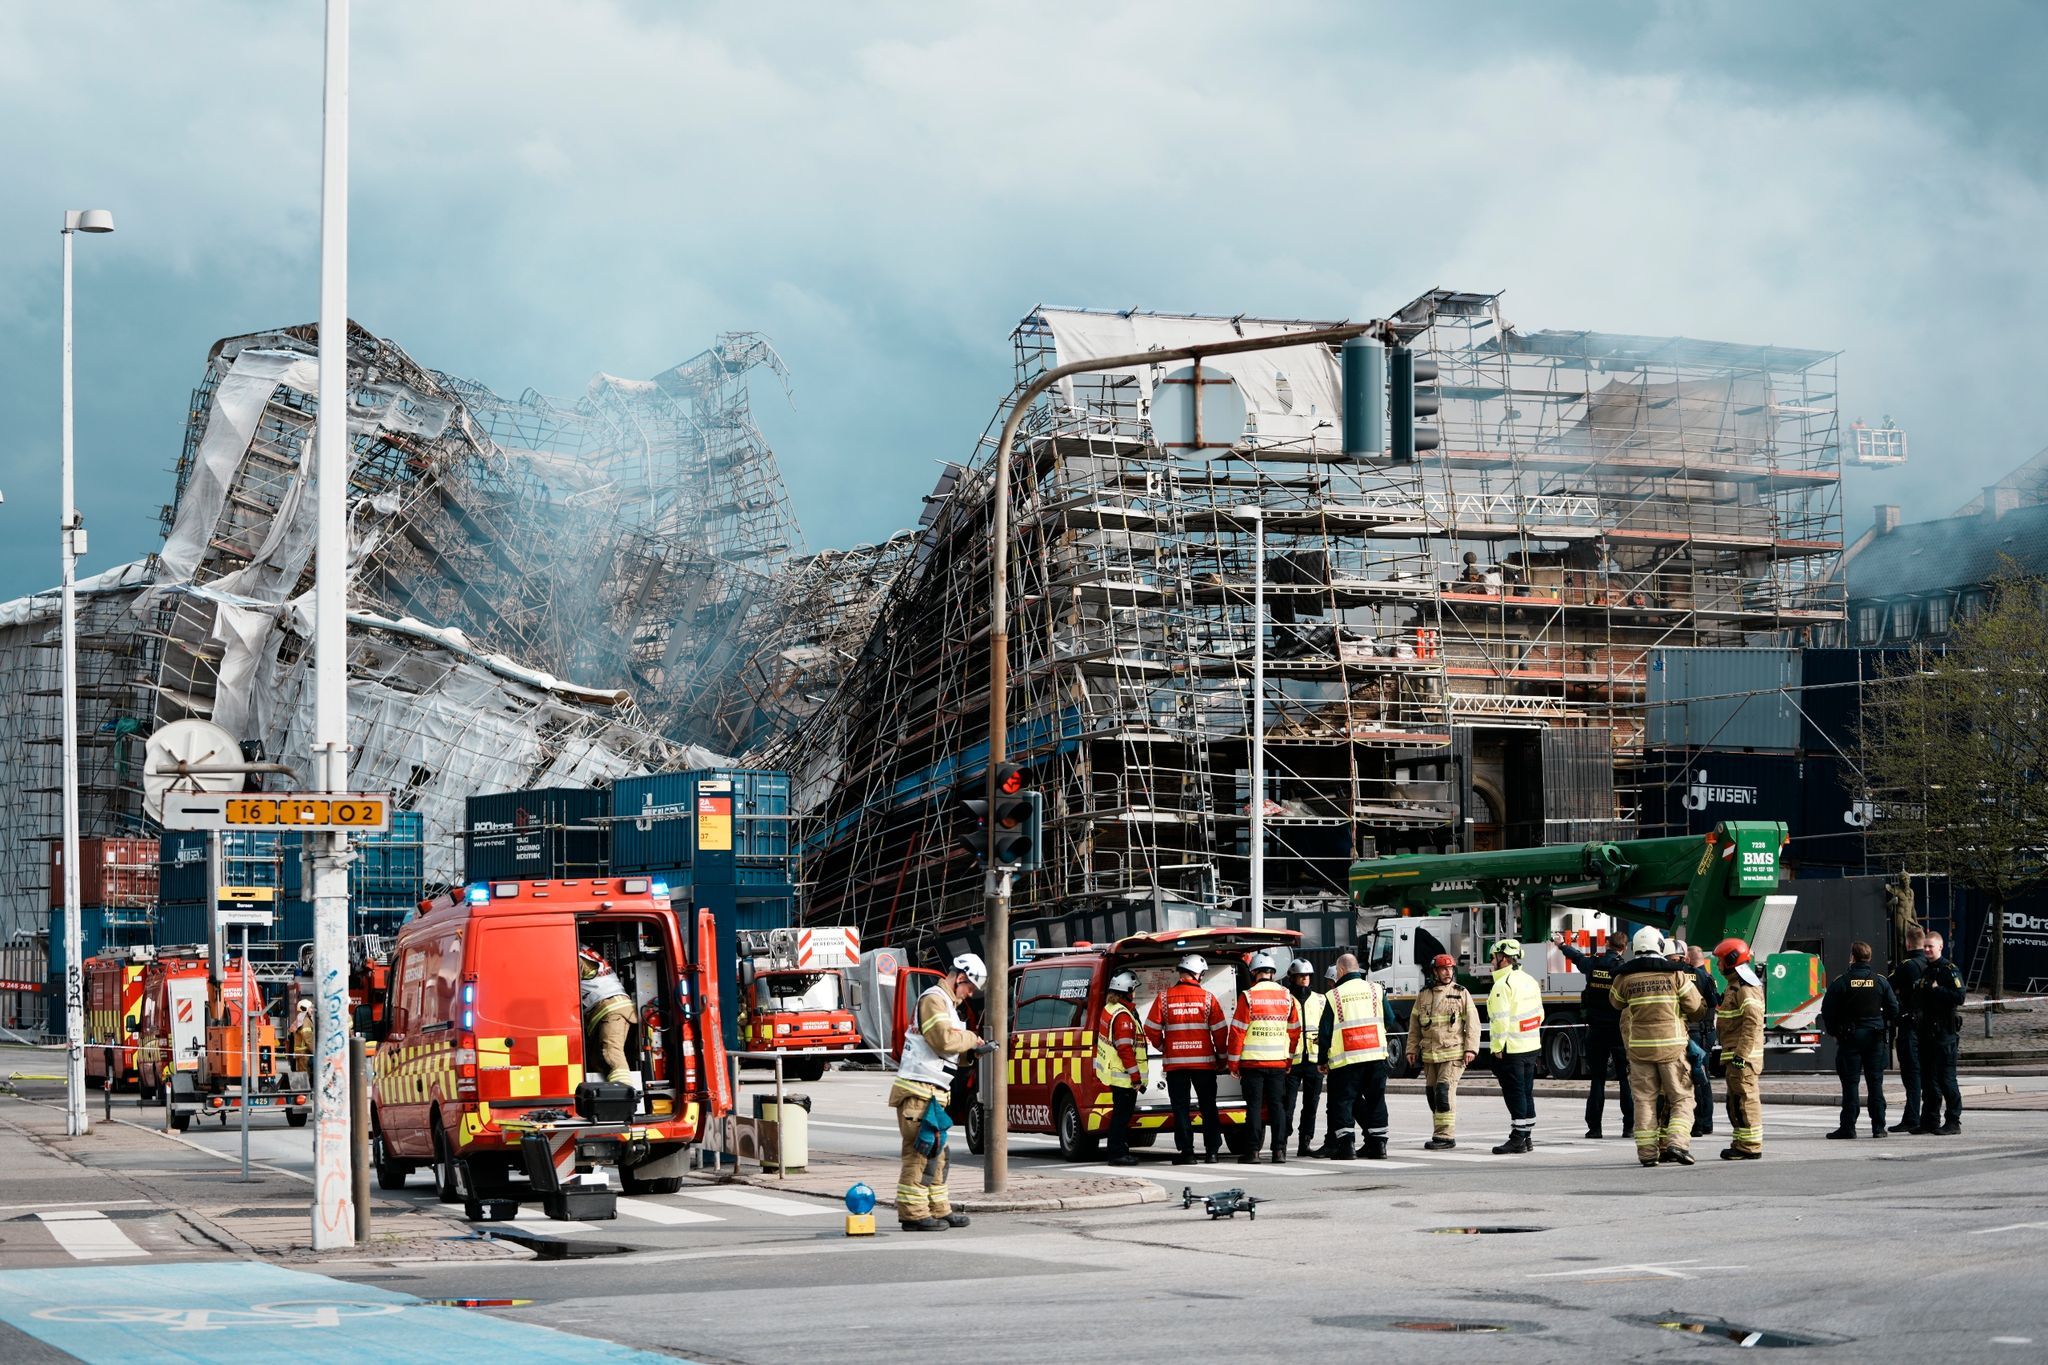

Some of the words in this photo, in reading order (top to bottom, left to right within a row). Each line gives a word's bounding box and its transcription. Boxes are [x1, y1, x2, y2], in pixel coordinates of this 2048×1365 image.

[241, 804, 261, 819] 16
[1743, 852, 1774, 865] BMS
[1020, 942, 1031, 959] P
